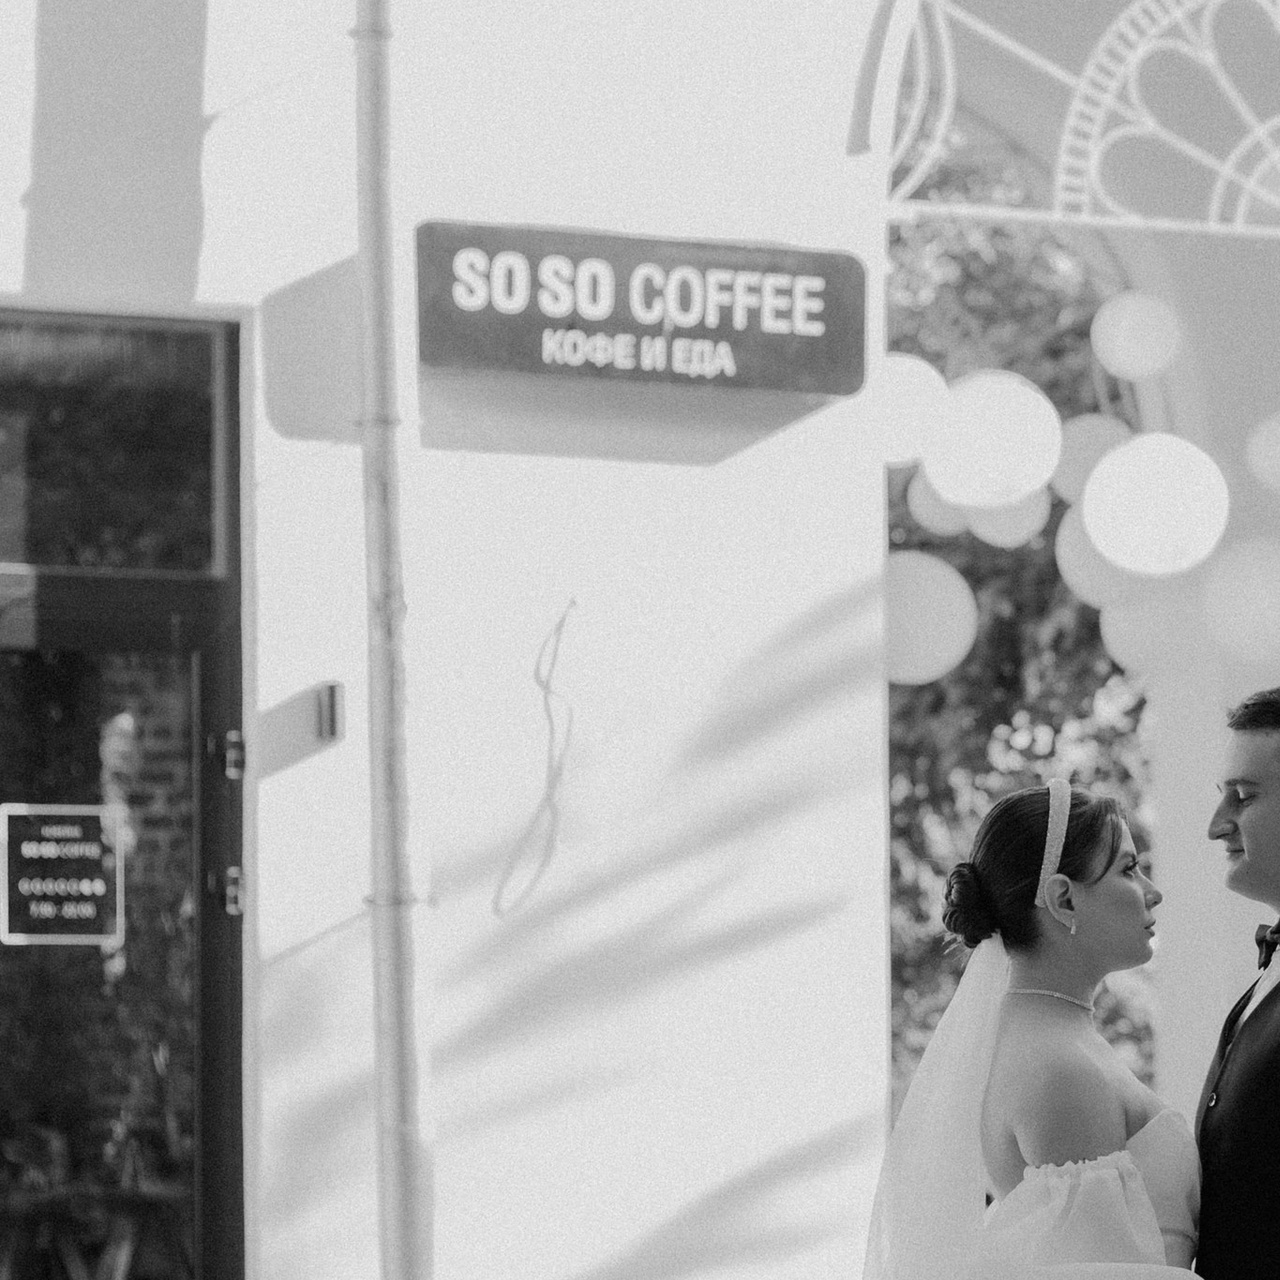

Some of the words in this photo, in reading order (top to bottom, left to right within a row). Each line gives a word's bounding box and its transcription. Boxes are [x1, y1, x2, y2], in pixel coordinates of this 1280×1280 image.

[452, 247, 531, 315] SO
[537, 254, 616, 321] SO
[629, 263, 826, 337] COFFEE
[542, 328, 636, 369] КОФЕ
[672, 337, 737, 378] ЕДА
